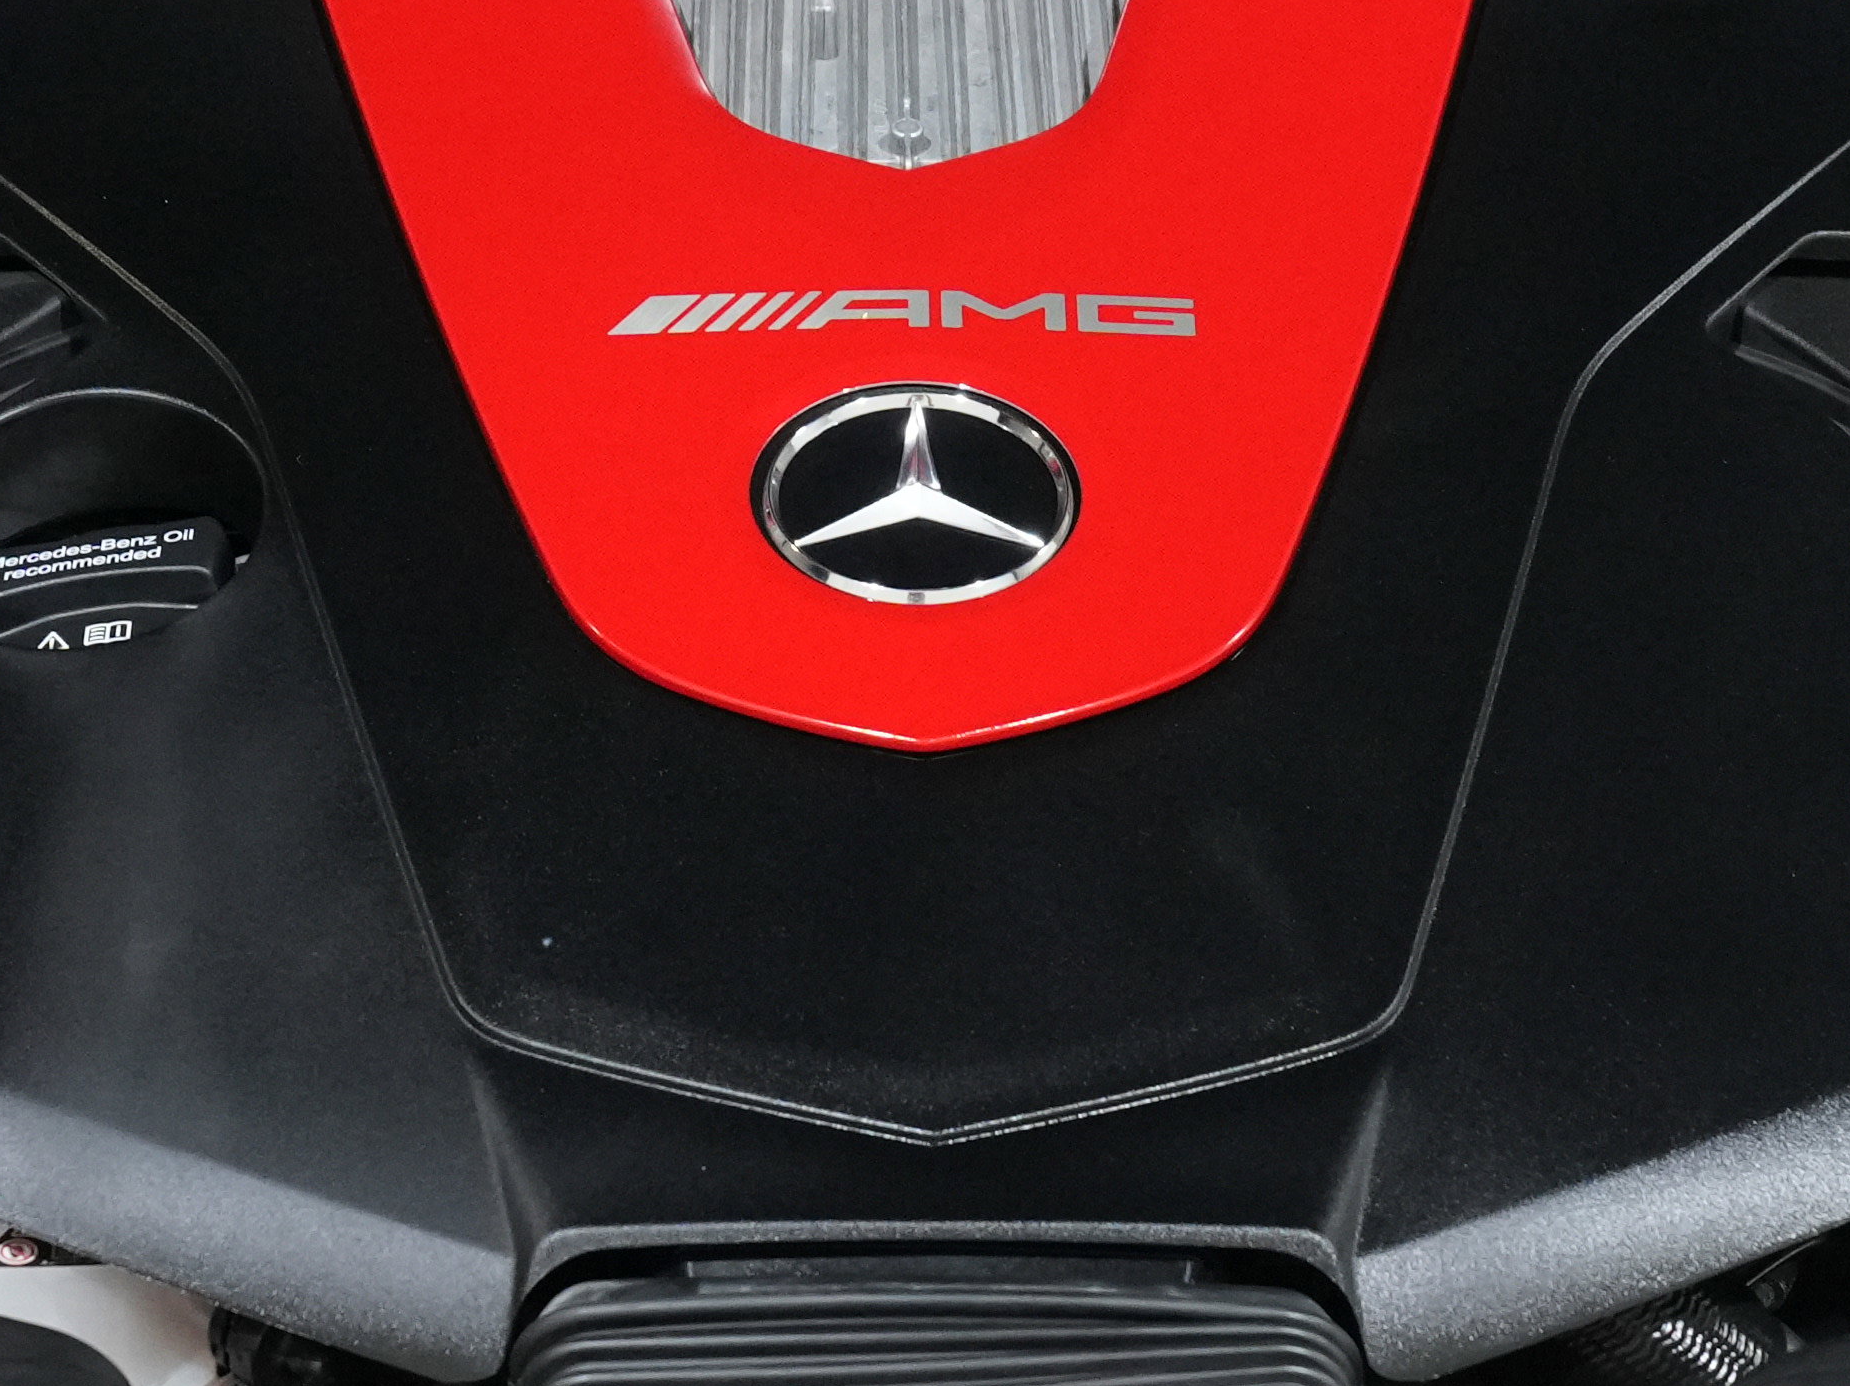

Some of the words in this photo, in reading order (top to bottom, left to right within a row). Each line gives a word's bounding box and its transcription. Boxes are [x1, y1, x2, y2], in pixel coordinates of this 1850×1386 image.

[796, 289, 1197, 337] AMG
[162, 527, 196, 544] Oil
[2, 545, 163, 582] recommended
